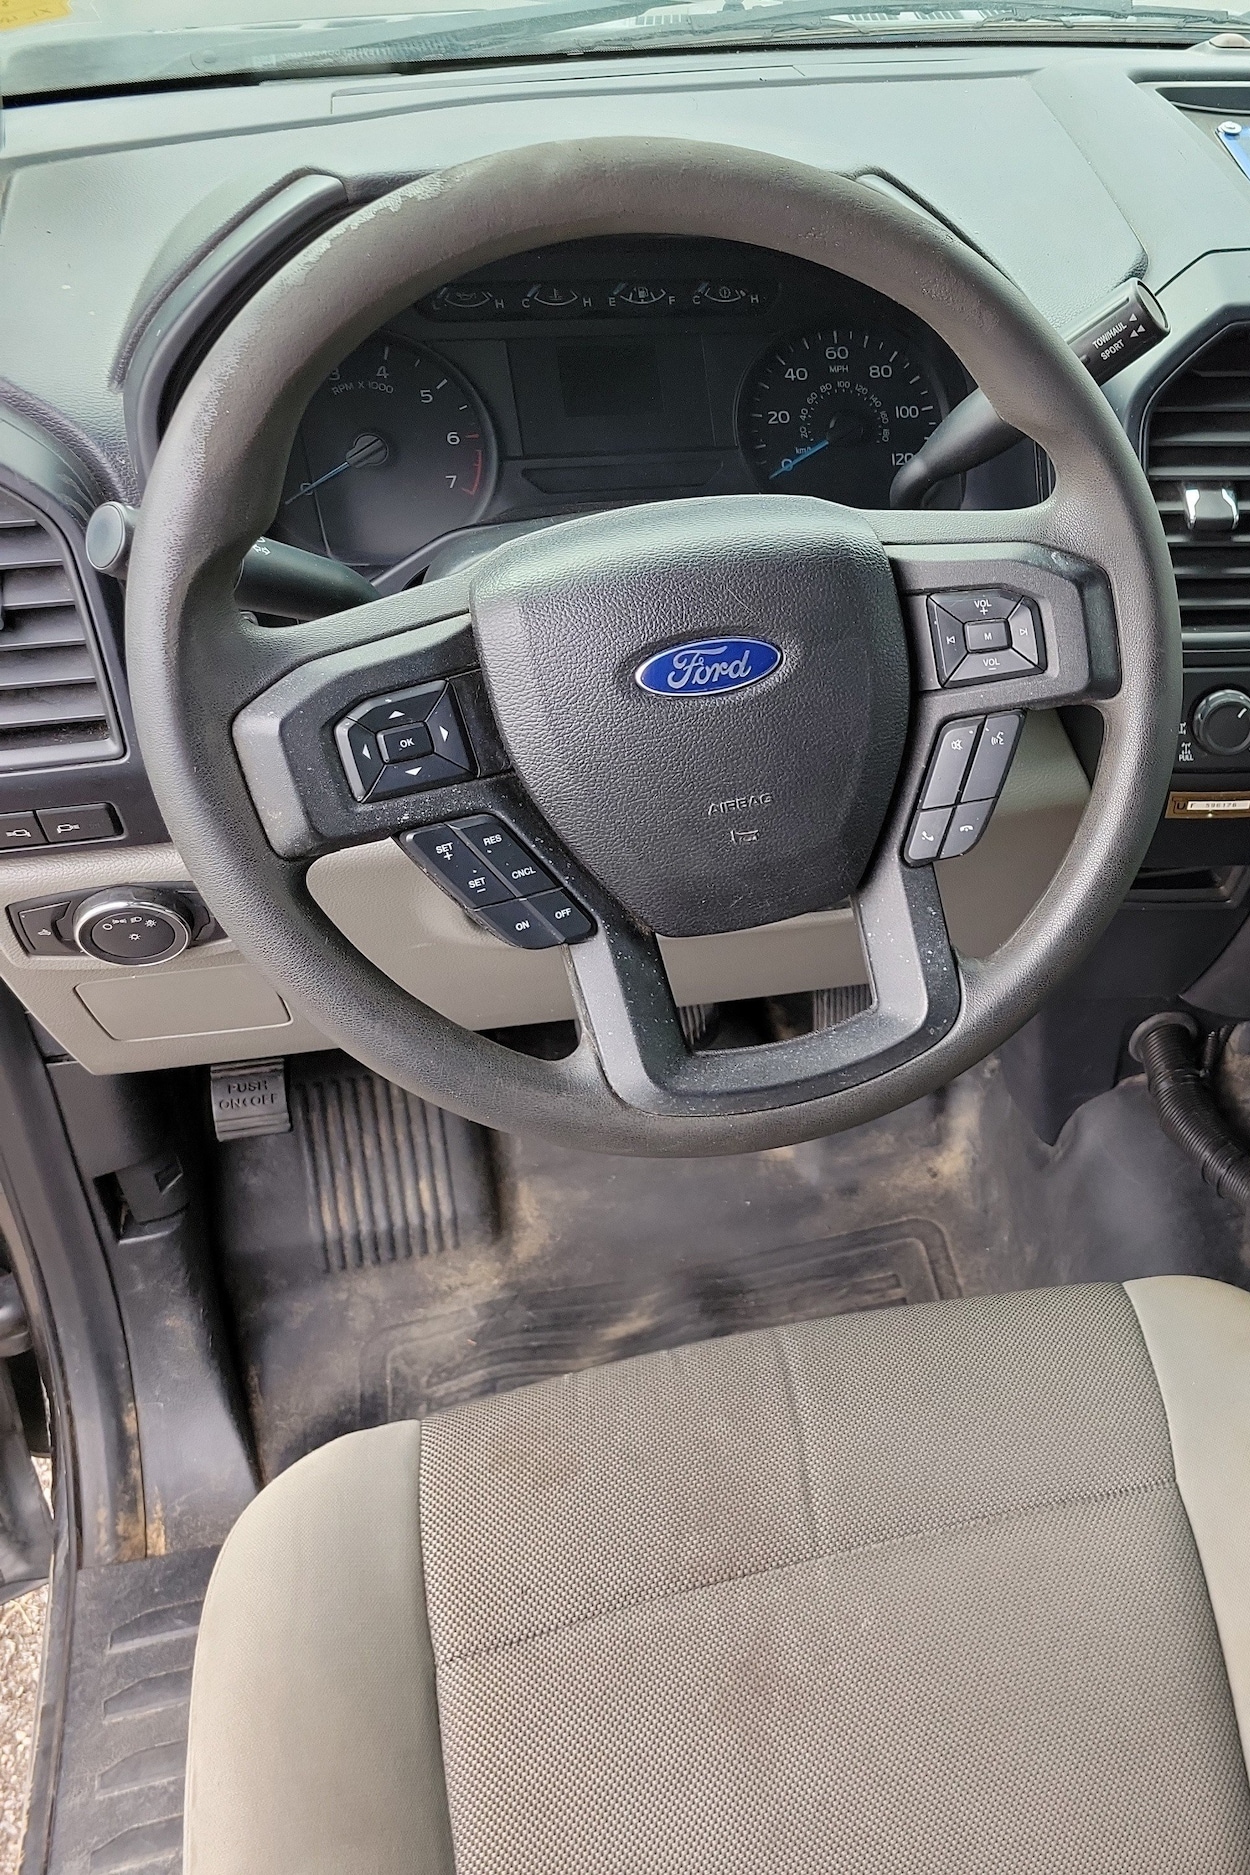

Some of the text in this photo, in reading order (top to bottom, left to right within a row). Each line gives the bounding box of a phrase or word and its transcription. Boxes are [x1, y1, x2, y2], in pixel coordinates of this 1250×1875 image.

[495, 299, 504, 309] H
[521, 299, 530, 308] C
[583, 298, 592, 307] H
[609, 298, 616, 307] E
[668, 296, 676, 305] F
[693, 296, 701, 305] C
[751, 295, 759, 304] H
[825, 346, 849, 360] 60
[1101, 339, 1125, 360] SPORT
[376, 366, 389, 378] 4
[784, 367, 808, 381] 40
[829, 365, 849, 373] MPH
[869, 365, 893, 378] 80
[332, 382, 353, 395] RPM
[369, 382, 394, 394] 1000
[820, 382, 832, 393] 80
[837, 380, 850, 388] 100
[855, 384, 868, 395] 120
[420, 390, 433, 403] 5
[807, 392, 818, 404] 60
[768, 410, 790, 424] 20
[800, 408, 808, 421] 40
[895, 405, 919, 419] 100
[447, 432, 460, 445] 6
[781, 459, 793, 471] 0
[445, 475, 457, 488] 7
[974, 599, 992, 608] VOL
[667, 645, 751, 689] Ford
[983, 658, 1000, 667] VOL
[400, 738, 415, 749] OK
[708, 793, 773, 815] AIRBAG
[483, 834, 502, 846] RES
[435, 843, 453, 854] SET
[511, 867, 536, 880] CNCL
[468, 877, 486, 889] SET
[555, 908, 572, 919] OFF
[515, 920, 530, 931] ON
[228, 1080, 268, 1094] PUSH
